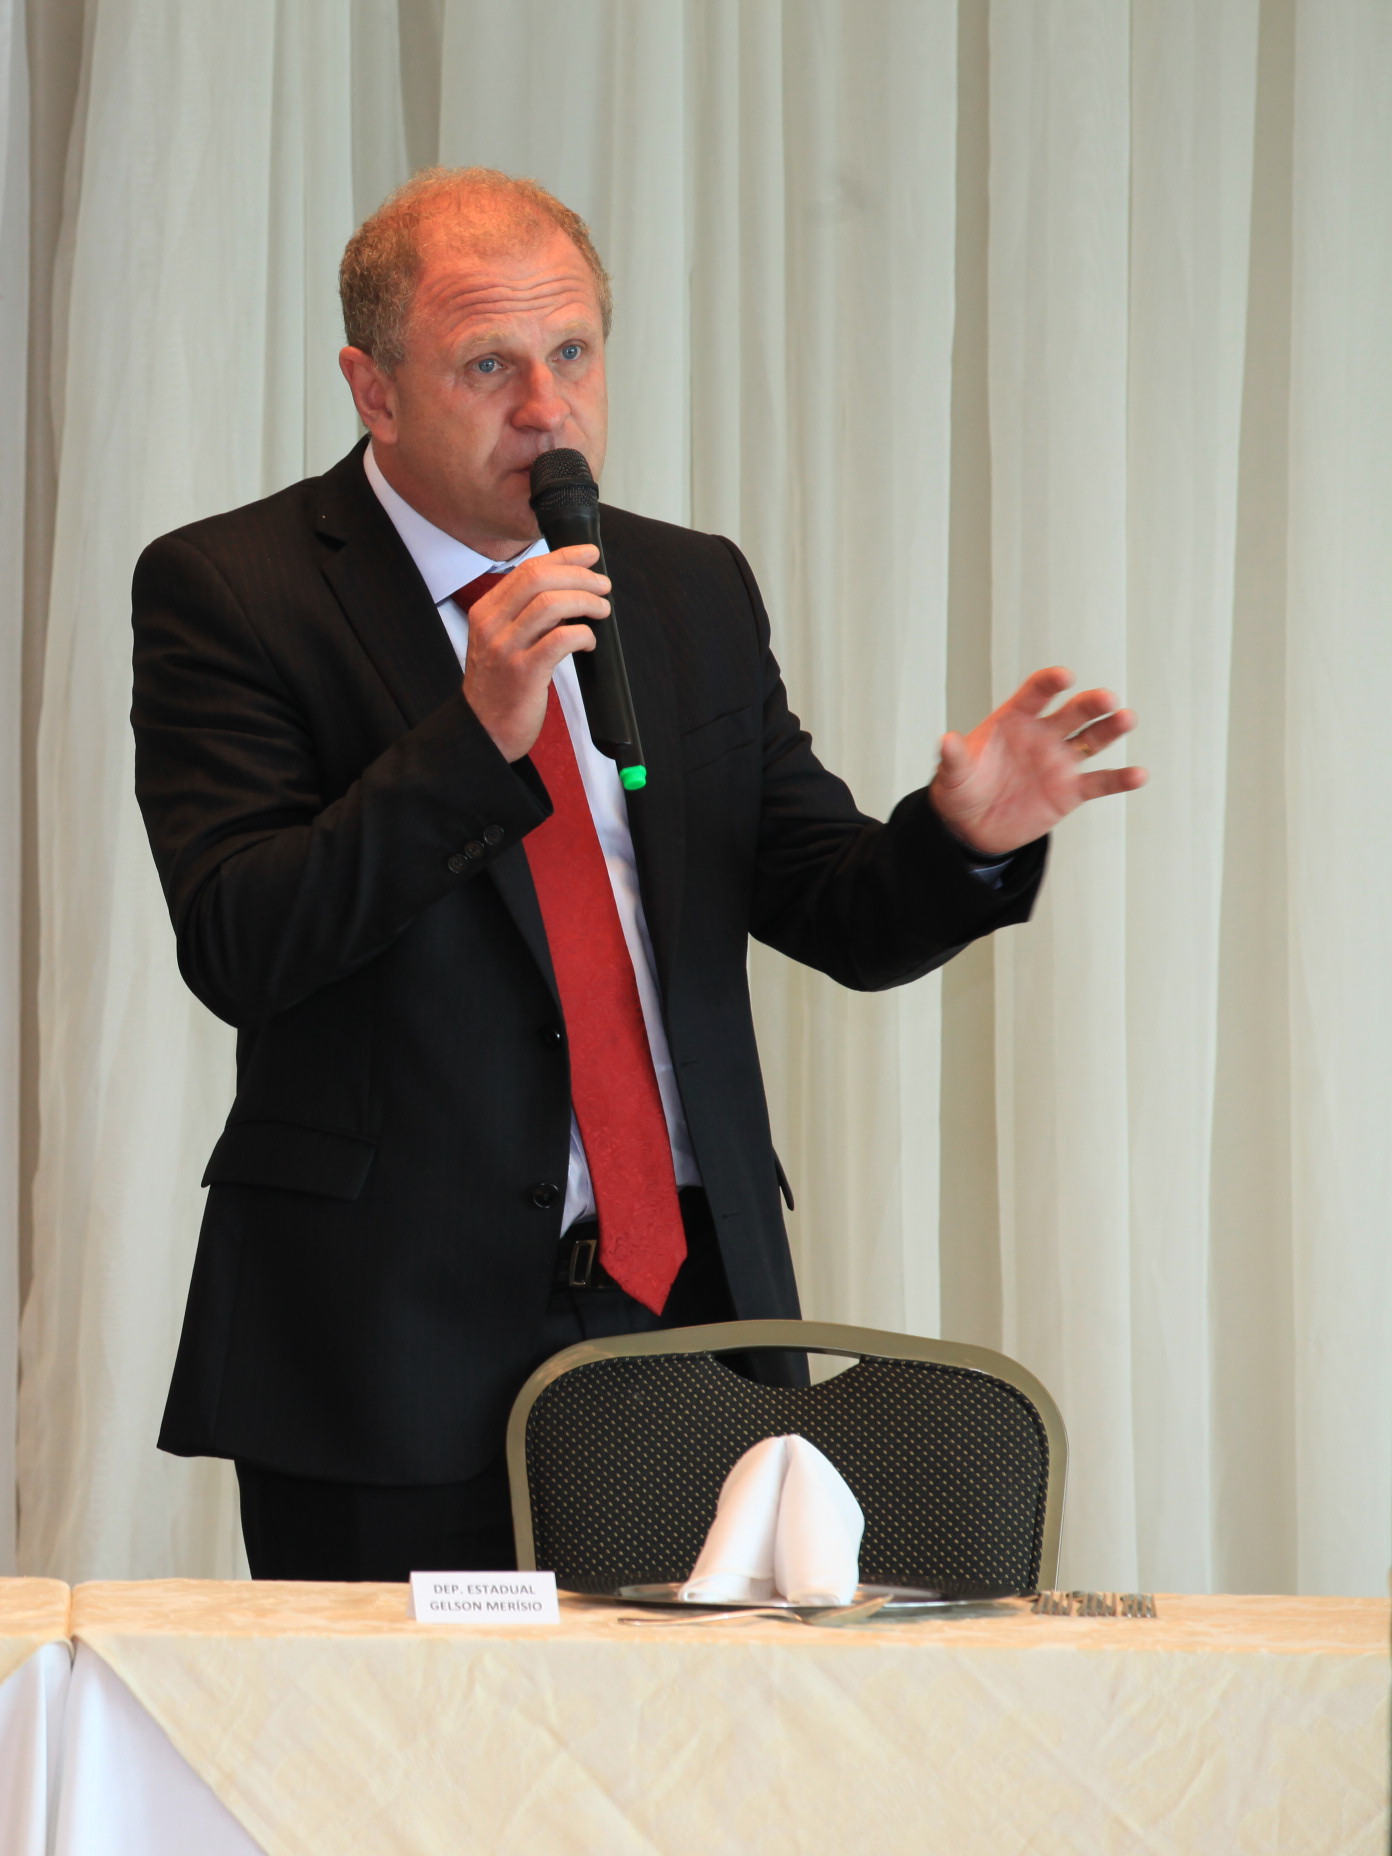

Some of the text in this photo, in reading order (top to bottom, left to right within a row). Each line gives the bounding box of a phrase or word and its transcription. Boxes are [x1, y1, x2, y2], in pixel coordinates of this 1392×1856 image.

[433, 1584, 536, 1595] DEP. ESTADUAL
[430, 1599, 542, 1612] GELSON MERÍSIO
